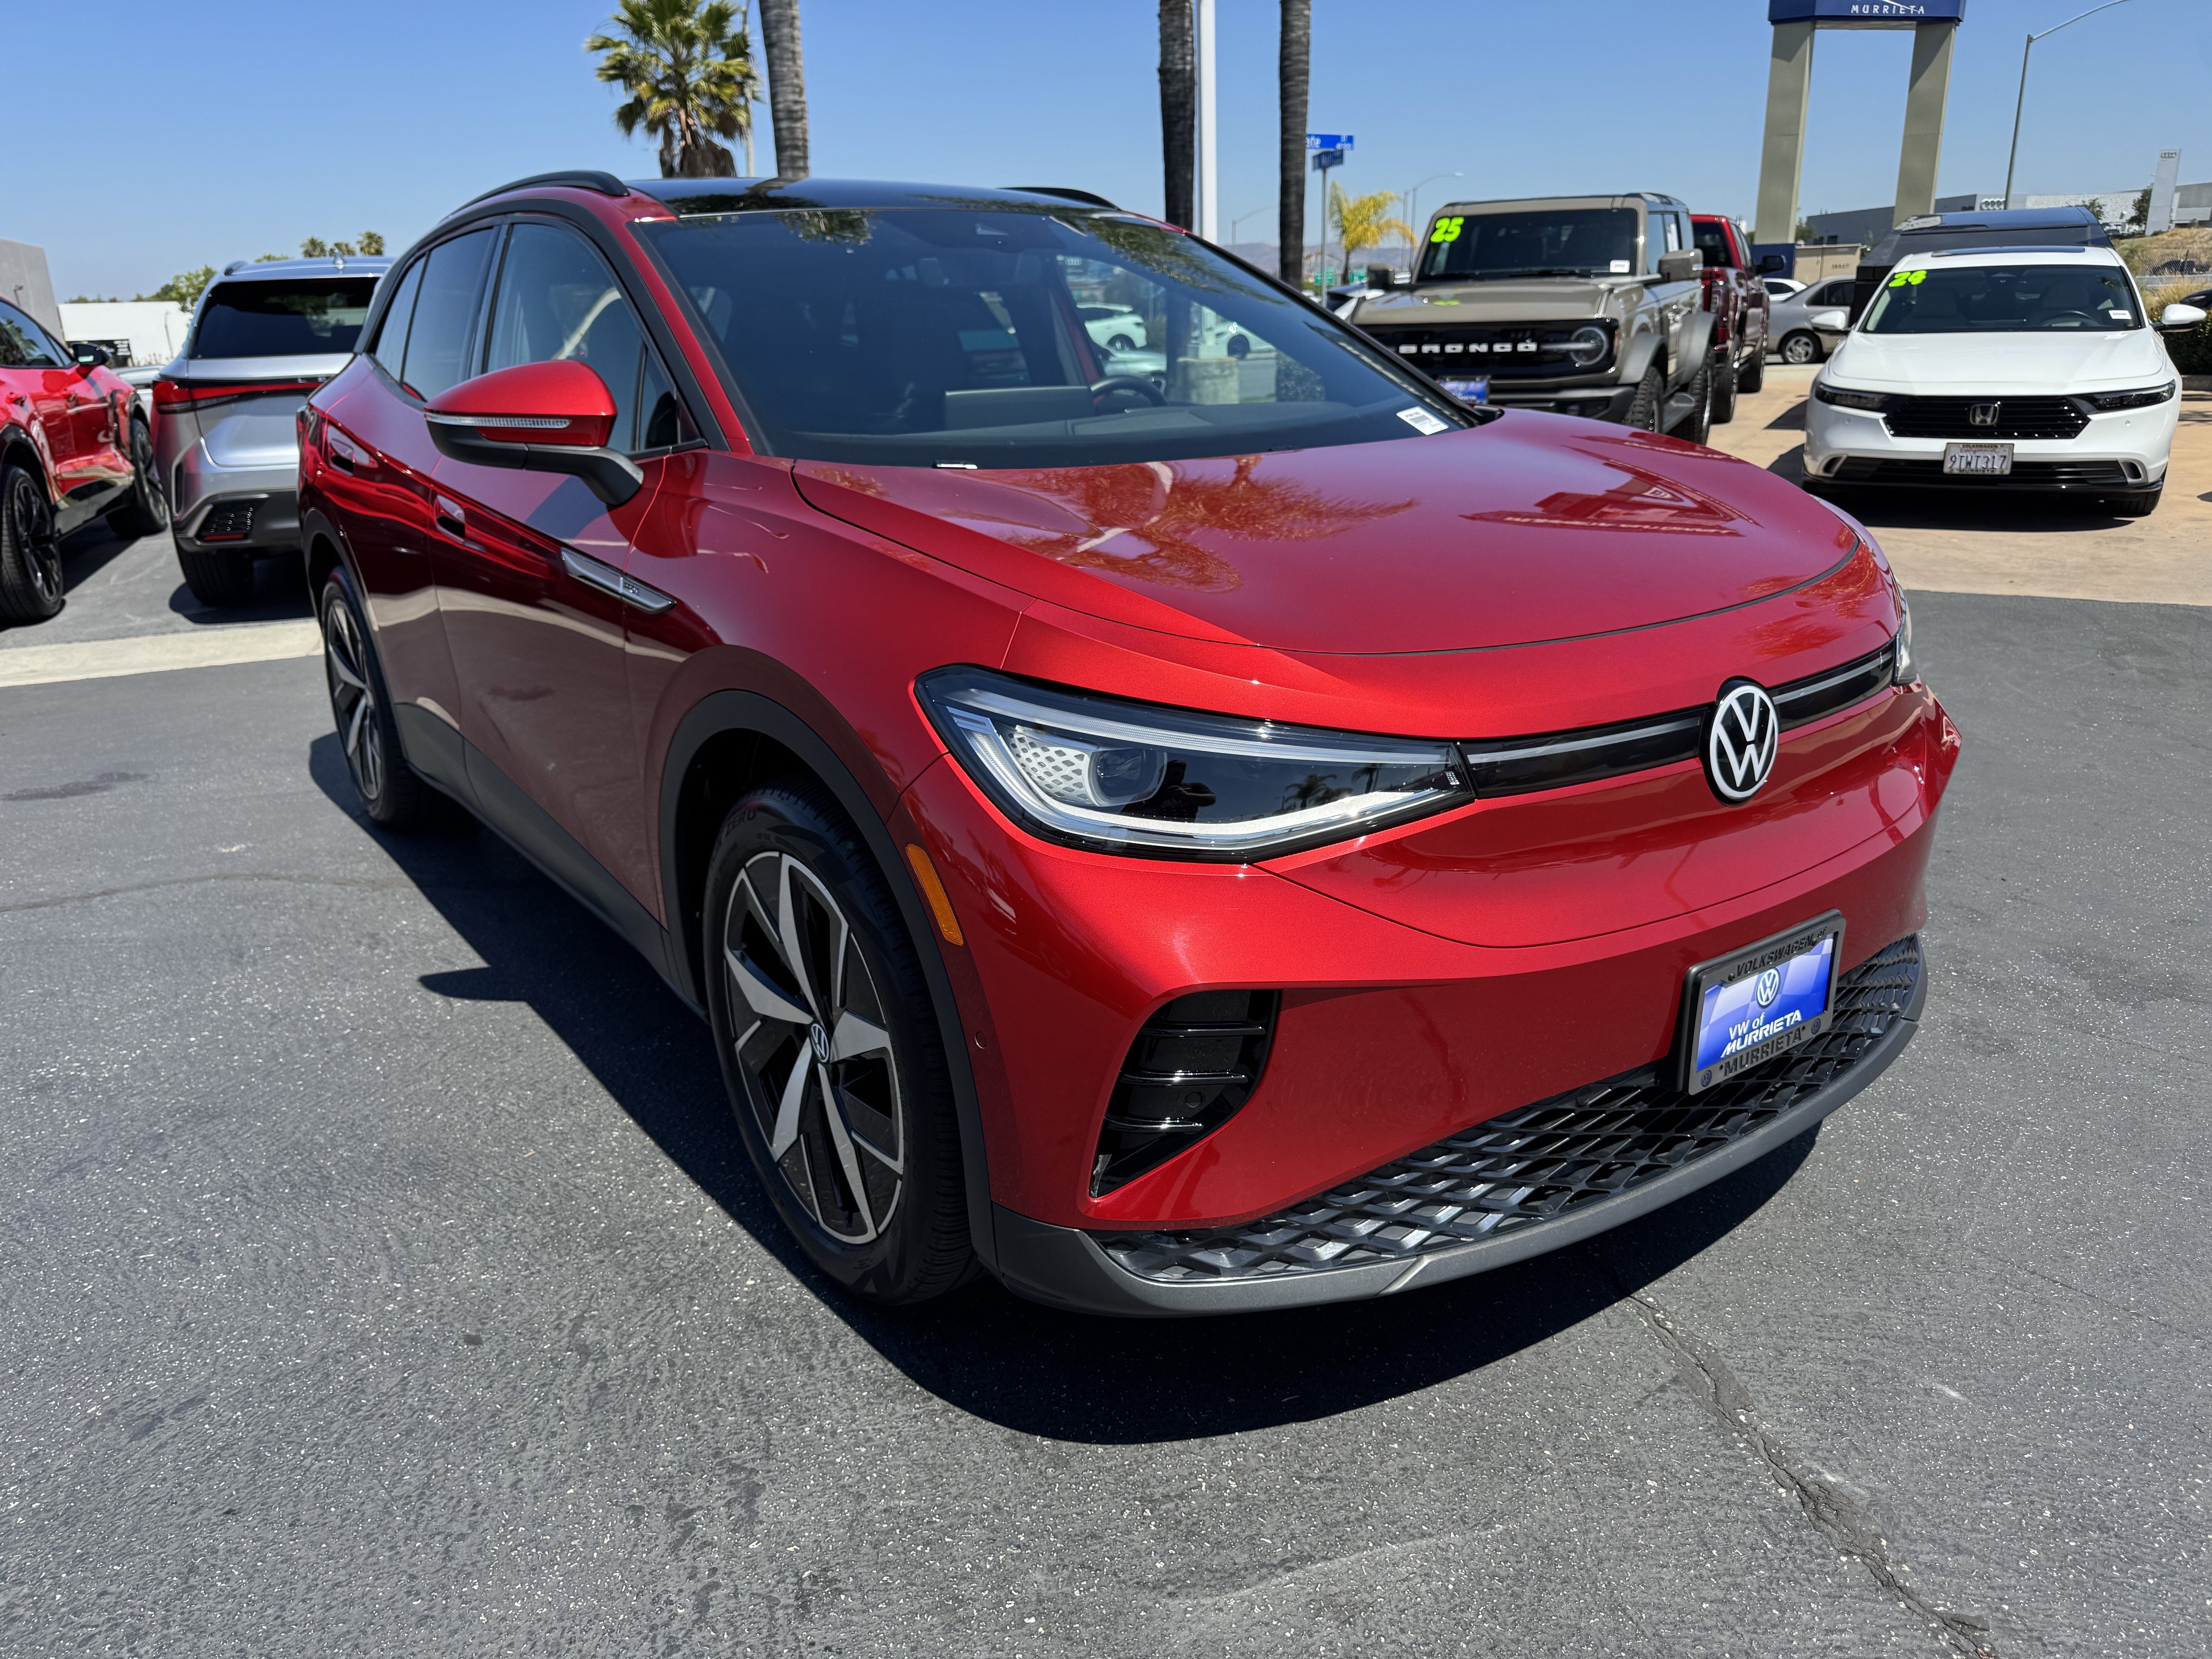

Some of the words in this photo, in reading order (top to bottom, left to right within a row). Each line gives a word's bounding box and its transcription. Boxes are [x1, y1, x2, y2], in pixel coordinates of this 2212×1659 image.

[1851, 5, 1925, 14] MURRIETA
[1430, 217, 1464, 243] 25
[1889, 270, 1927, 287] 24
[1399, 342, 1537, 354] BRONCO
[1736, 934, 1813, 977] VOLKSWAGEN
[1720, 1009, 1802, 1058] MURRIETA
[1729, 1019, 1750, 1040] VW
[1752, 1012, 1765, 1029] of
[1724, 1027, 1802, 1076] MURRIETA
